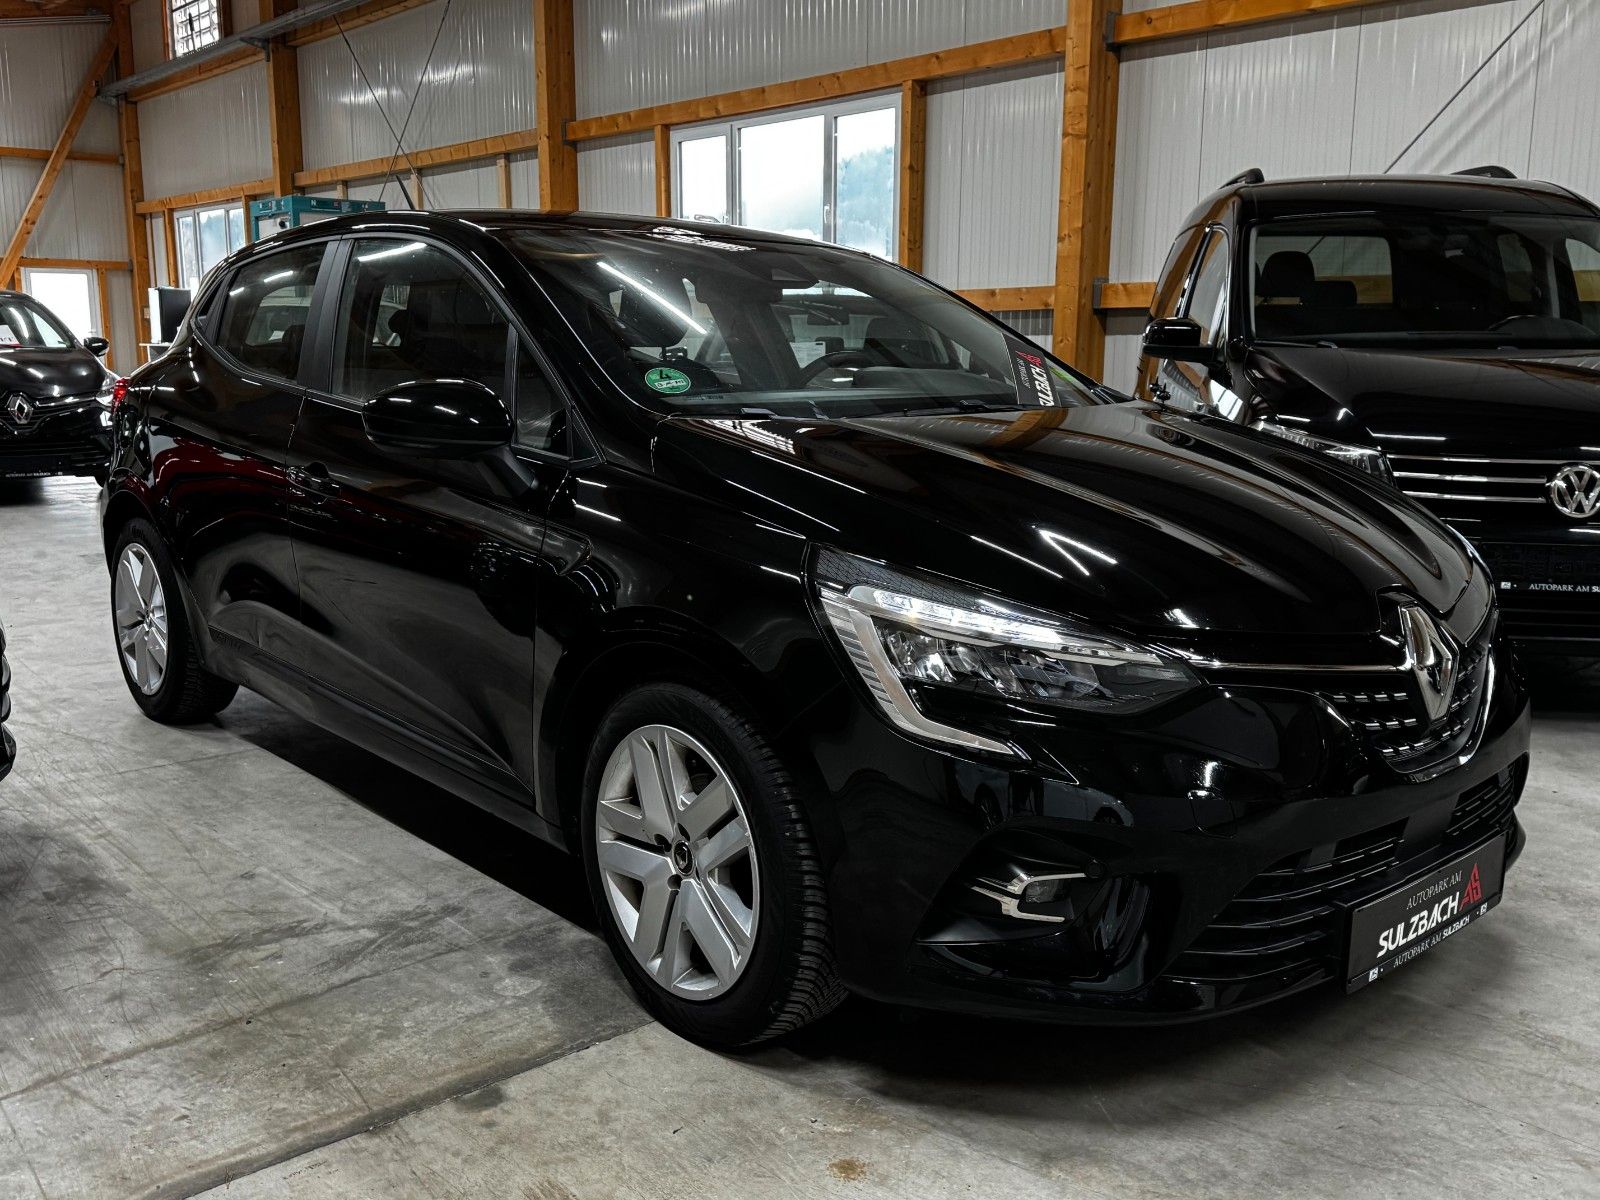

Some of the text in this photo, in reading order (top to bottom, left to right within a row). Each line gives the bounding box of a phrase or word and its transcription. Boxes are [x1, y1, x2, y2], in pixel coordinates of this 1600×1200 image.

[1528, 583, 1574, 592] AUTOPARK
[1575, 585, 1590, 593] AM
[1406, 870, 1463, 910] AUTOPARK AM
[1376, 891, 1460, 959] SULZBACH
[1393, 914, 1470, 968] AUTOPARK AM SULZBACH
